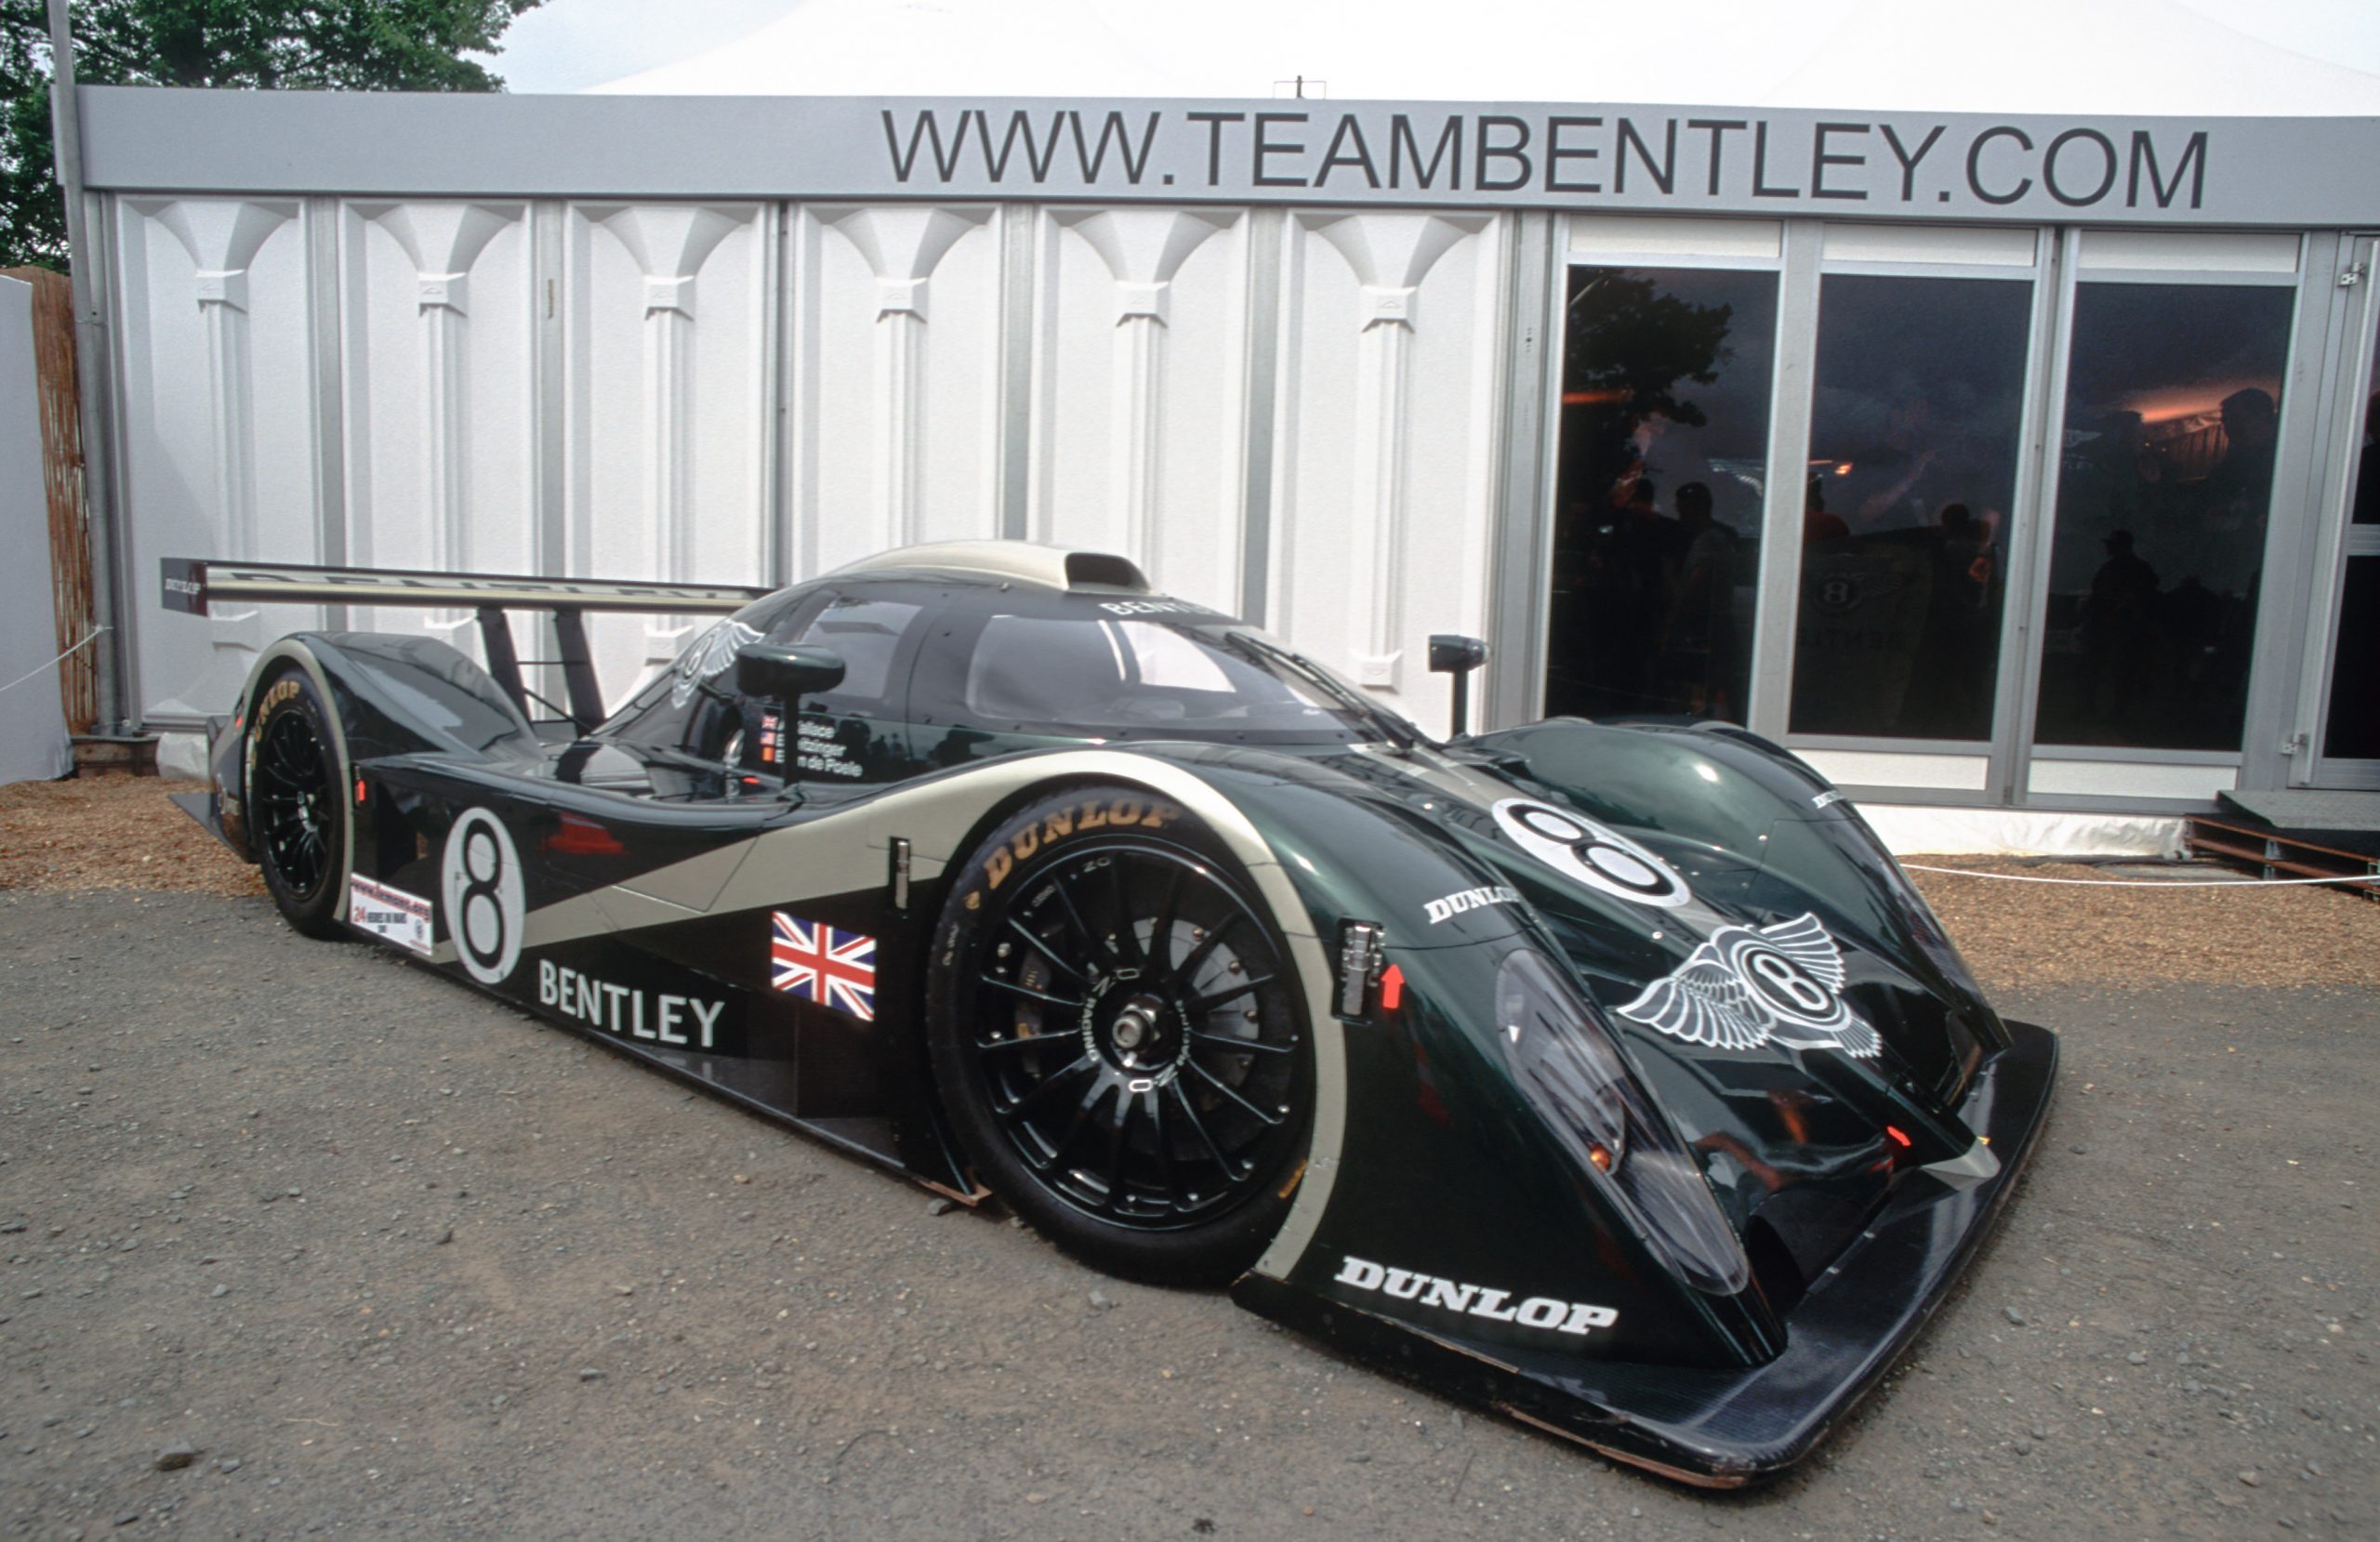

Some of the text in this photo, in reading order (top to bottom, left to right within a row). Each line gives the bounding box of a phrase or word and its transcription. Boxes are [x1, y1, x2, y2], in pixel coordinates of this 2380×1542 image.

[881, 109, 2209, 210] WWW.TEAMBENTLEY.COM
[983, 799, 1183, 890] DUNLOP
[1506, 803, 1674, 898] 8
[462, 817, 506, 970] 8
[1423, 885, 1521, 925] DUNLO
[539, 958, 725, 1048] BENTLEY
[1333, 1255, 1620, 1336] DUNLOP
